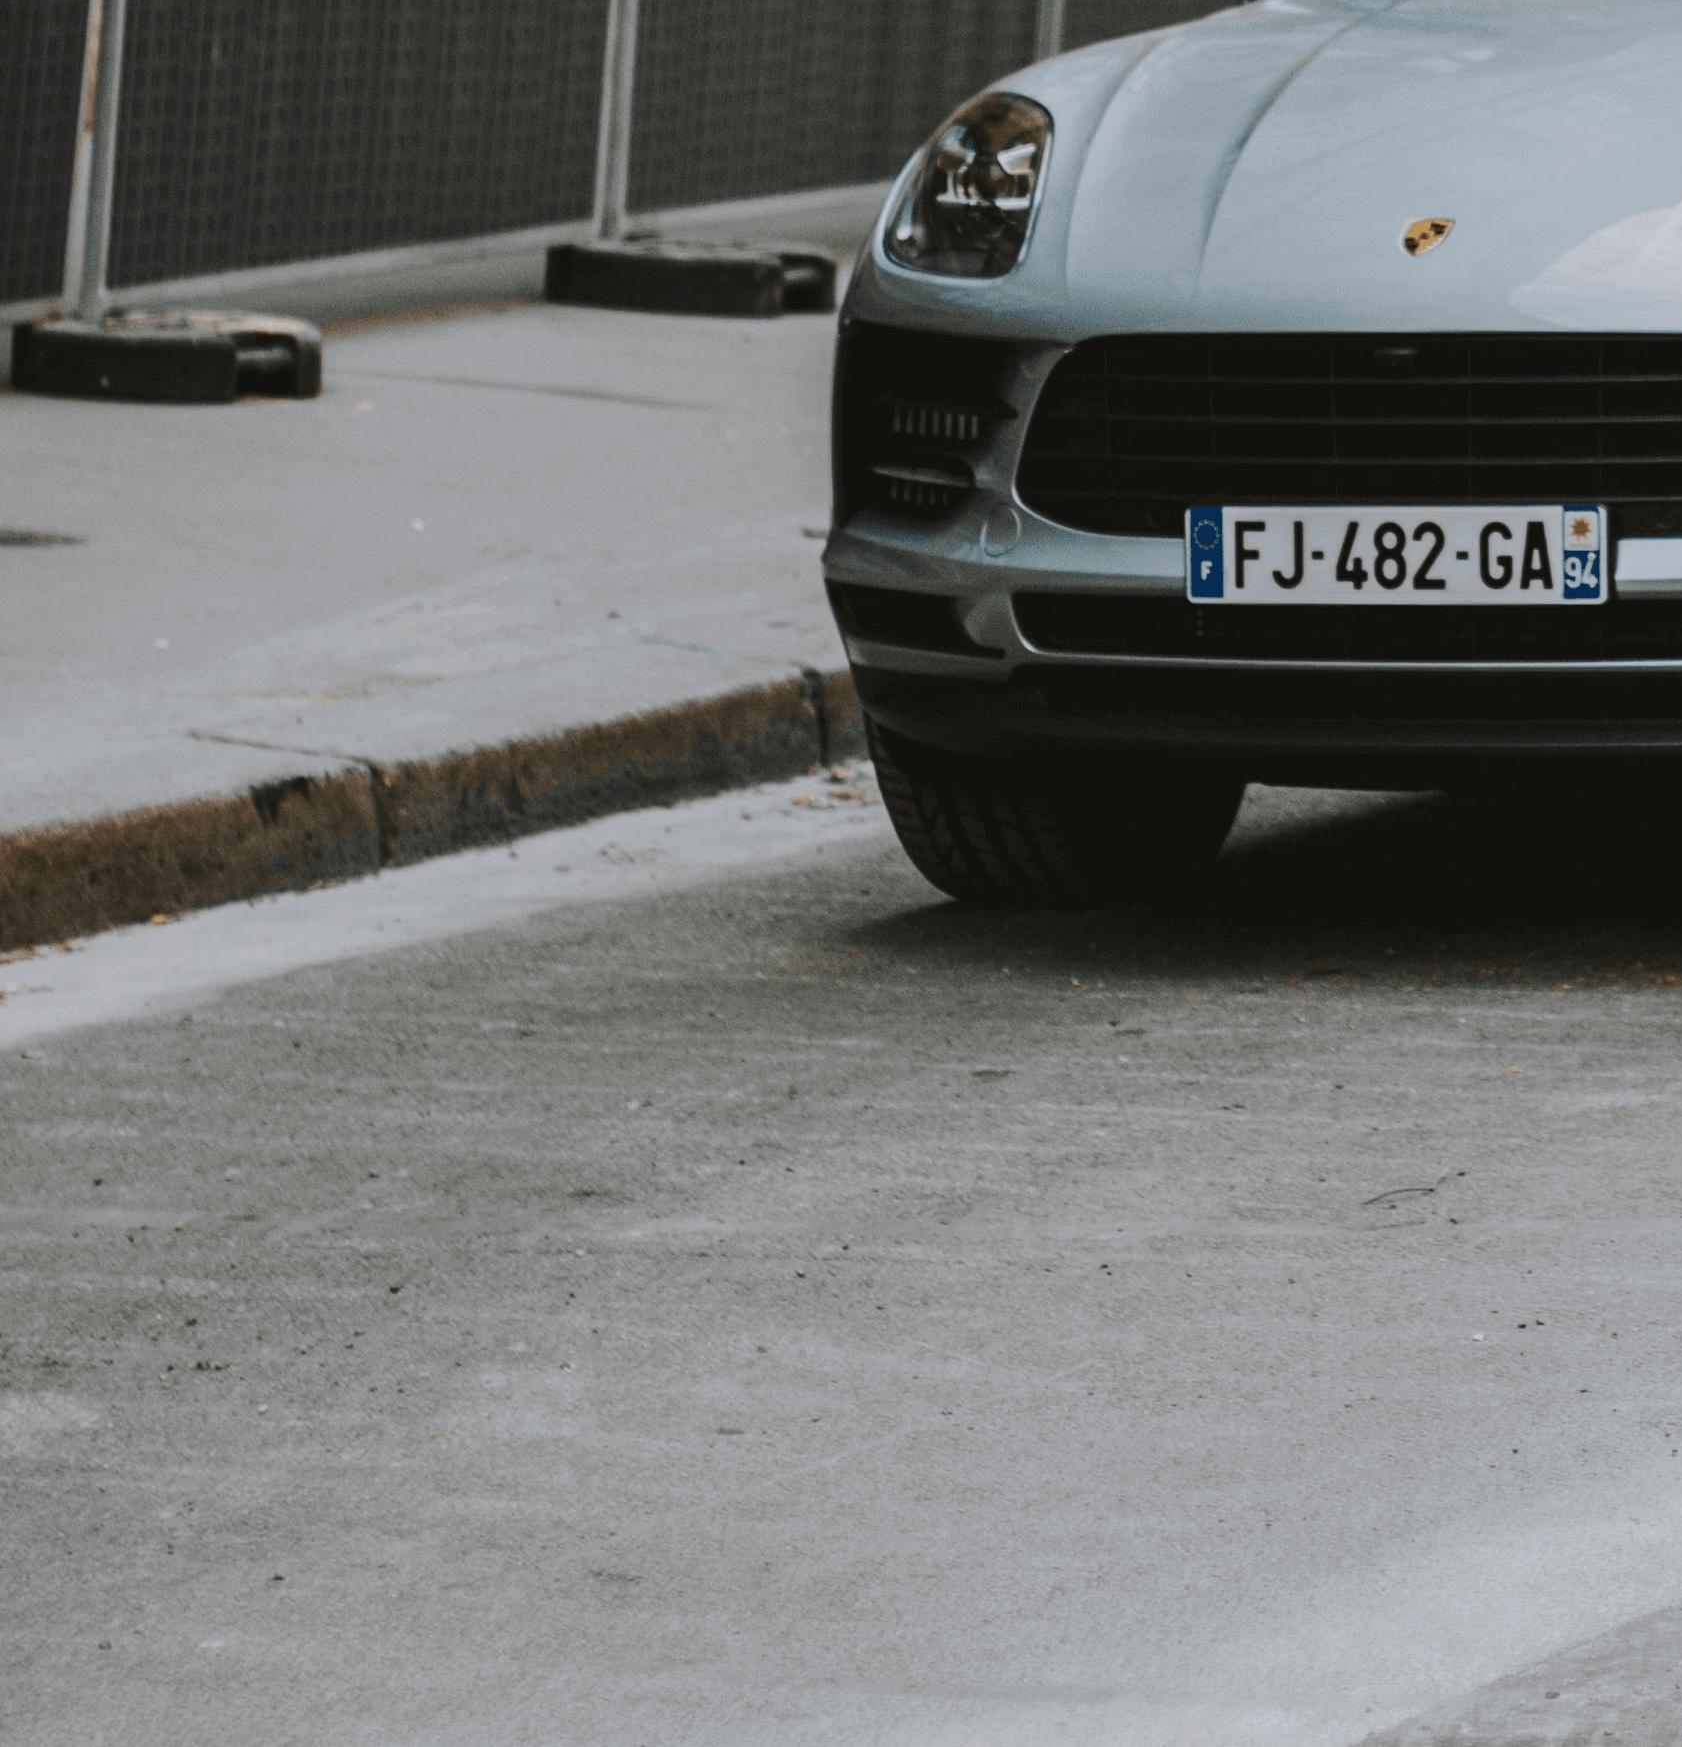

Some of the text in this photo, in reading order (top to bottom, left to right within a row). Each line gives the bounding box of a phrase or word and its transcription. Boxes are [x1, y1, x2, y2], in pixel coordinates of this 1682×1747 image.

[1200, 560, 1213, 581] F
[1234, 520, 1553, 590] FJ-482-GA
[1565, 552, 1599, 589] 94
